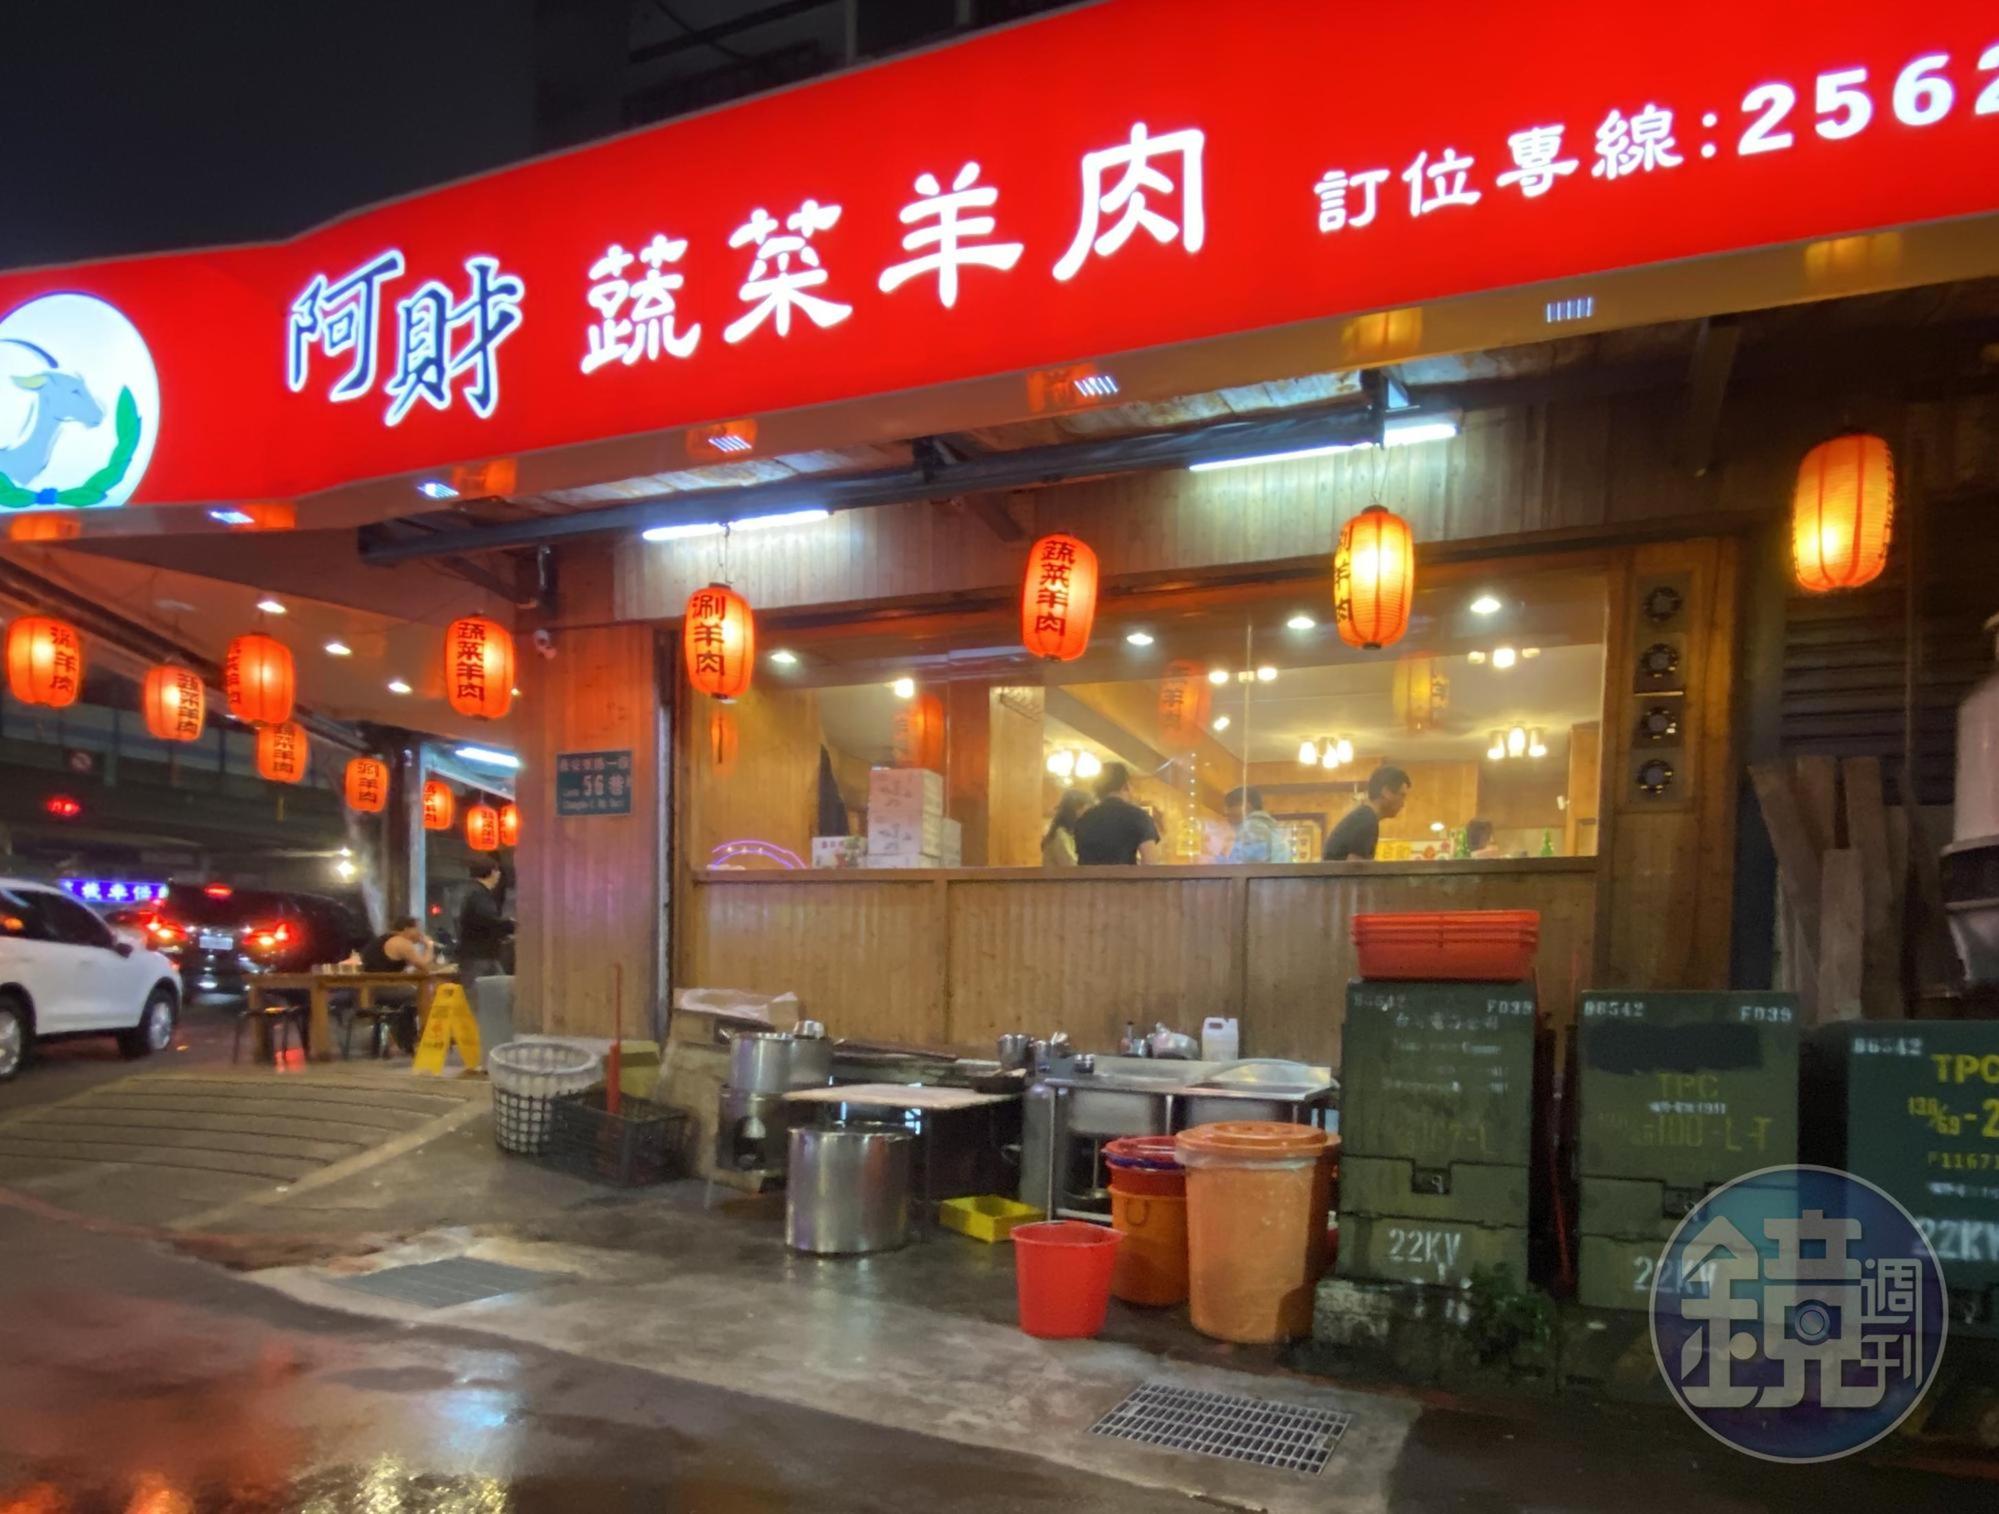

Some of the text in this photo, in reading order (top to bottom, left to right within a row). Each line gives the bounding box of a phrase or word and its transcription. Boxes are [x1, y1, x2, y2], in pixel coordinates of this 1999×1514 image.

[284, 121, 1206, 429] 阿財 蔬菜羊肉
[1035, 540, 1075, 636] 蔬菜羊肉
[456, 621, 486, 701] 蔬菜羊肉
[692, 595, 726, 677] 涮羊肉
[1388, 1228, 1461, 1266] 22KV
